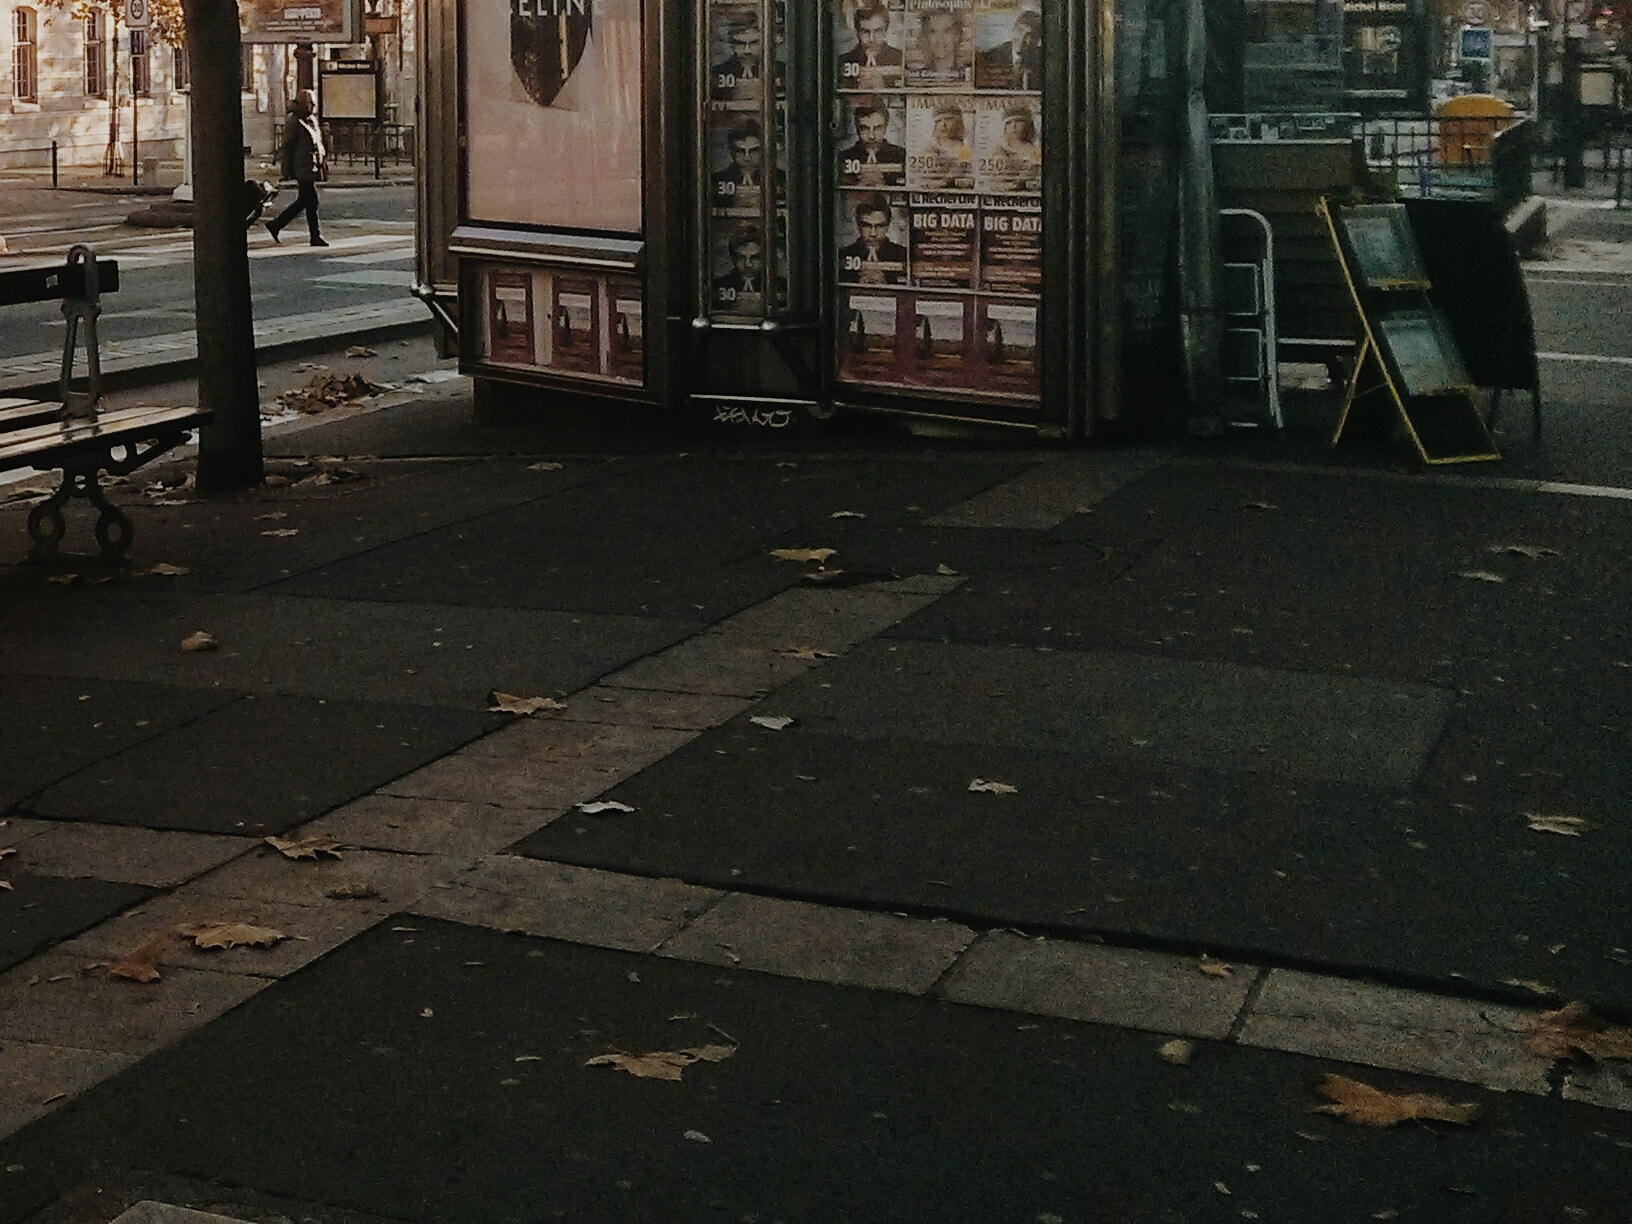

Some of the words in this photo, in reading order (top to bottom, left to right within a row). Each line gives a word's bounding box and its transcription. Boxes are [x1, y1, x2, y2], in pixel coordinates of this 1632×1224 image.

[843, 62, 859, 76] 30
[718, 74, 736, 88] 30
[844, 159, 860, 173] 30
[718, 181, 736, 195] 30
[913, 214, 937, 228] BIG
[941, 213, 974, 228] DATA
[984, 216, 1008, 231] BIG
[844, 256, 861, 270] 30
